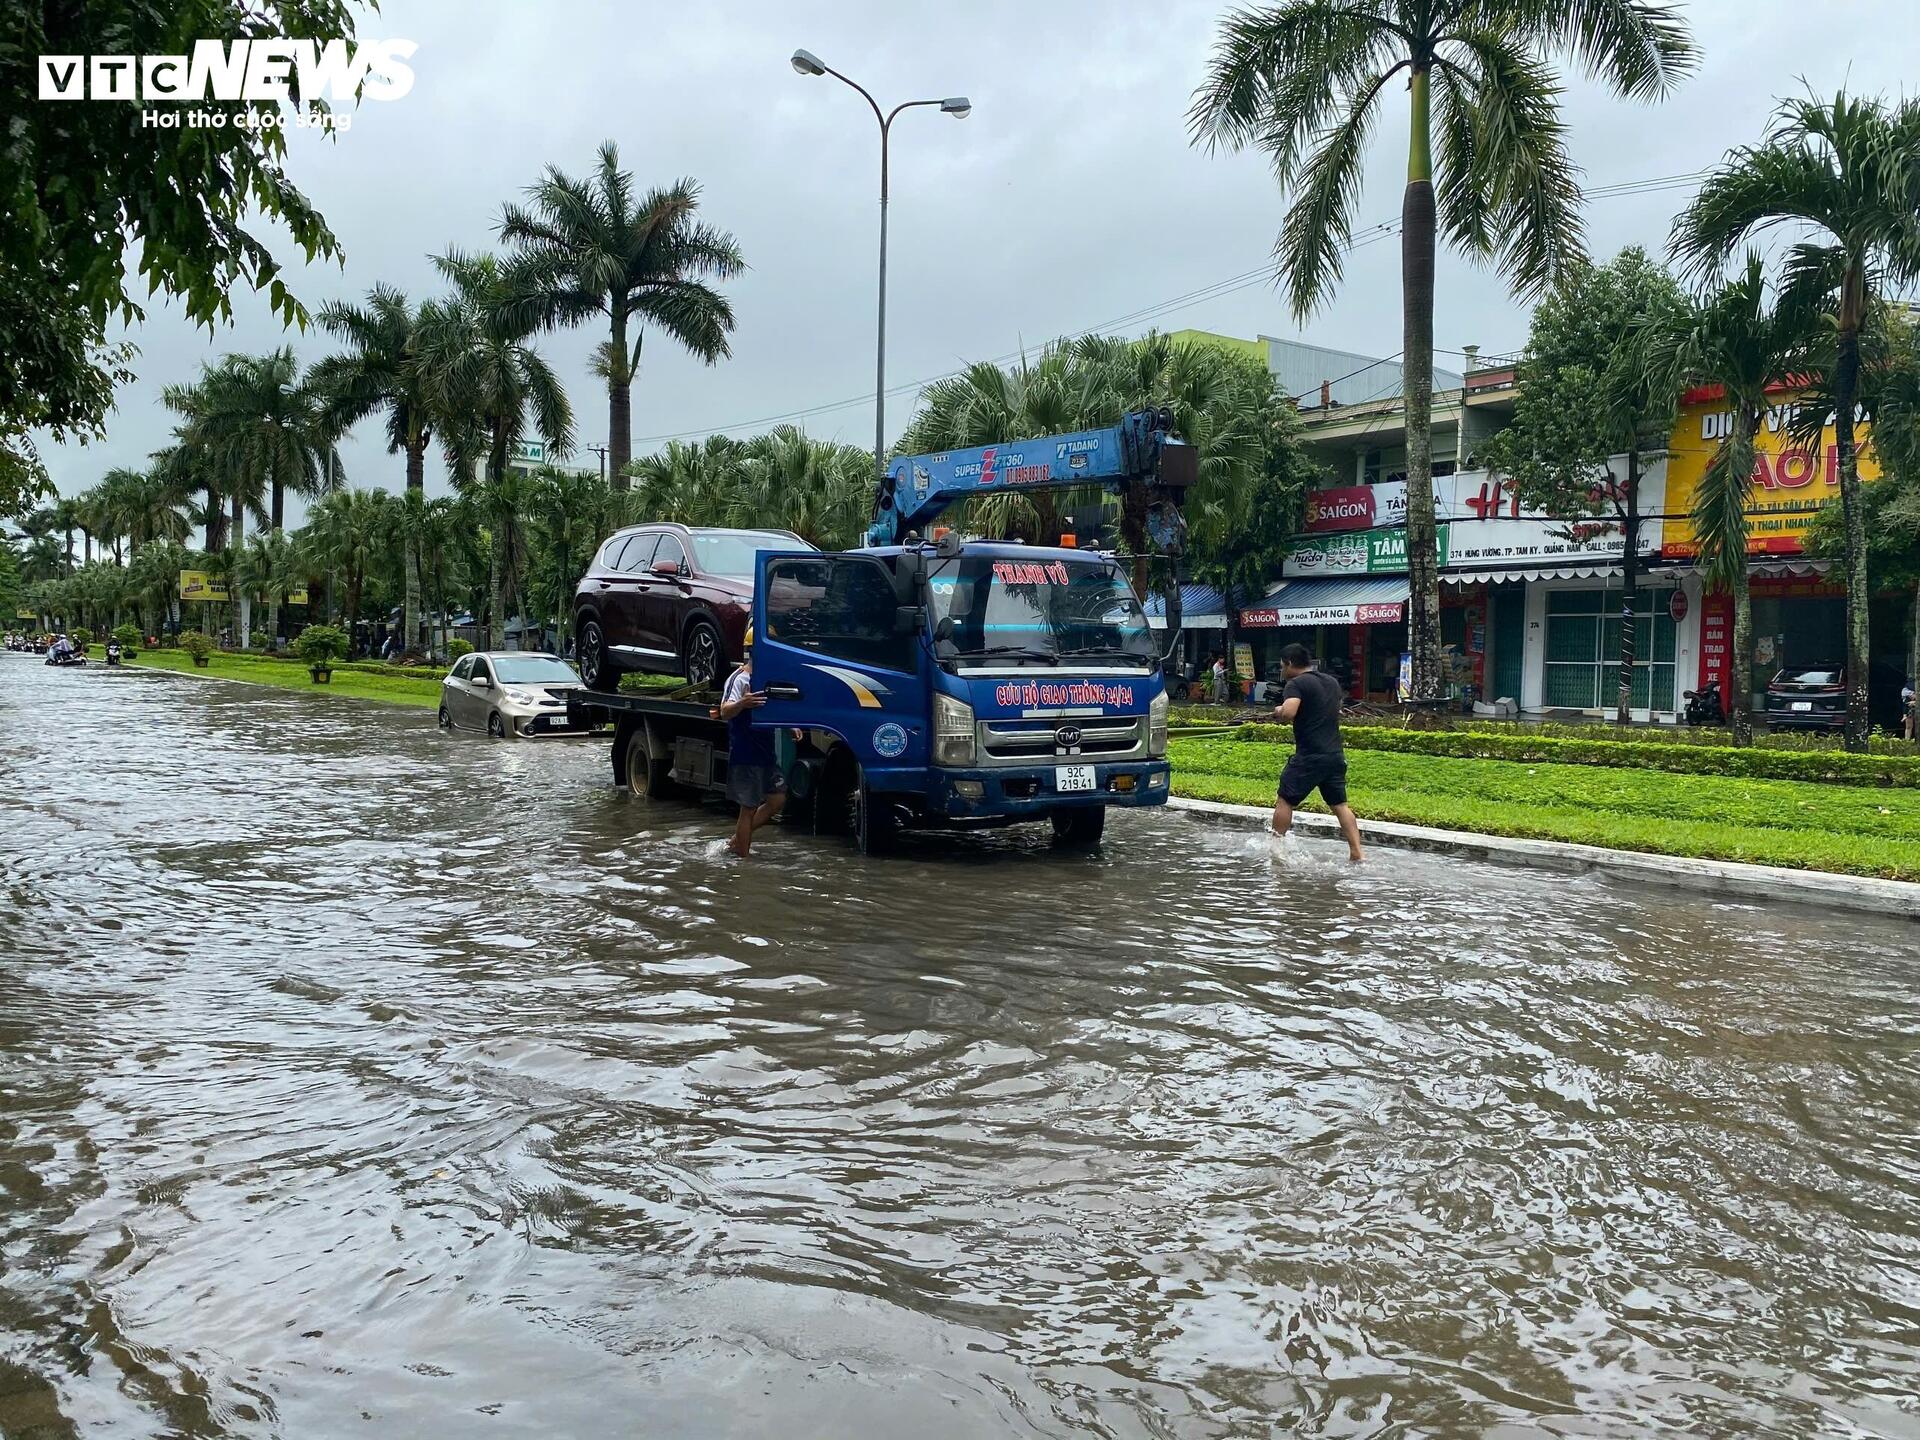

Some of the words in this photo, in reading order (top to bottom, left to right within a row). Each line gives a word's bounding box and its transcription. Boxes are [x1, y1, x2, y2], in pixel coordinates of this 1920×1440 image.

[1068, 439, 1099, 453] TADANO
[955, 465, 981, 477] SUPER
[1319, 503, 1367, 519] SAIGON
[1373, 538, 1404, 556] TÂM
[1450, 550, 1462, 559] 374
[1566, 543, 1580, 553] NAM
[1294, 551, 1323, 566] huda
[993, 563, 1048, 585] THANH
[1249, 614, 1276, 623] SAIGON
[1309, 608, 1328, 619] TÂM
[1330, 609, 1350, 618] NGA
[1368, 608, 1400, 618] SAIGON
[1704, 645, 1724, 653] TRAO
[1707, 673, 1718, 681] XE
[1022, 680, 1038, 710] HỘ
[1039, 686, 1068, 704] GIAO
[1105, 685, 1133, 708] 24/24
[1060, 732, 1079, 740] TMT
[1067, 767, 1084, 777] 92C
[1061, 779, 1092, 790] 219.41
